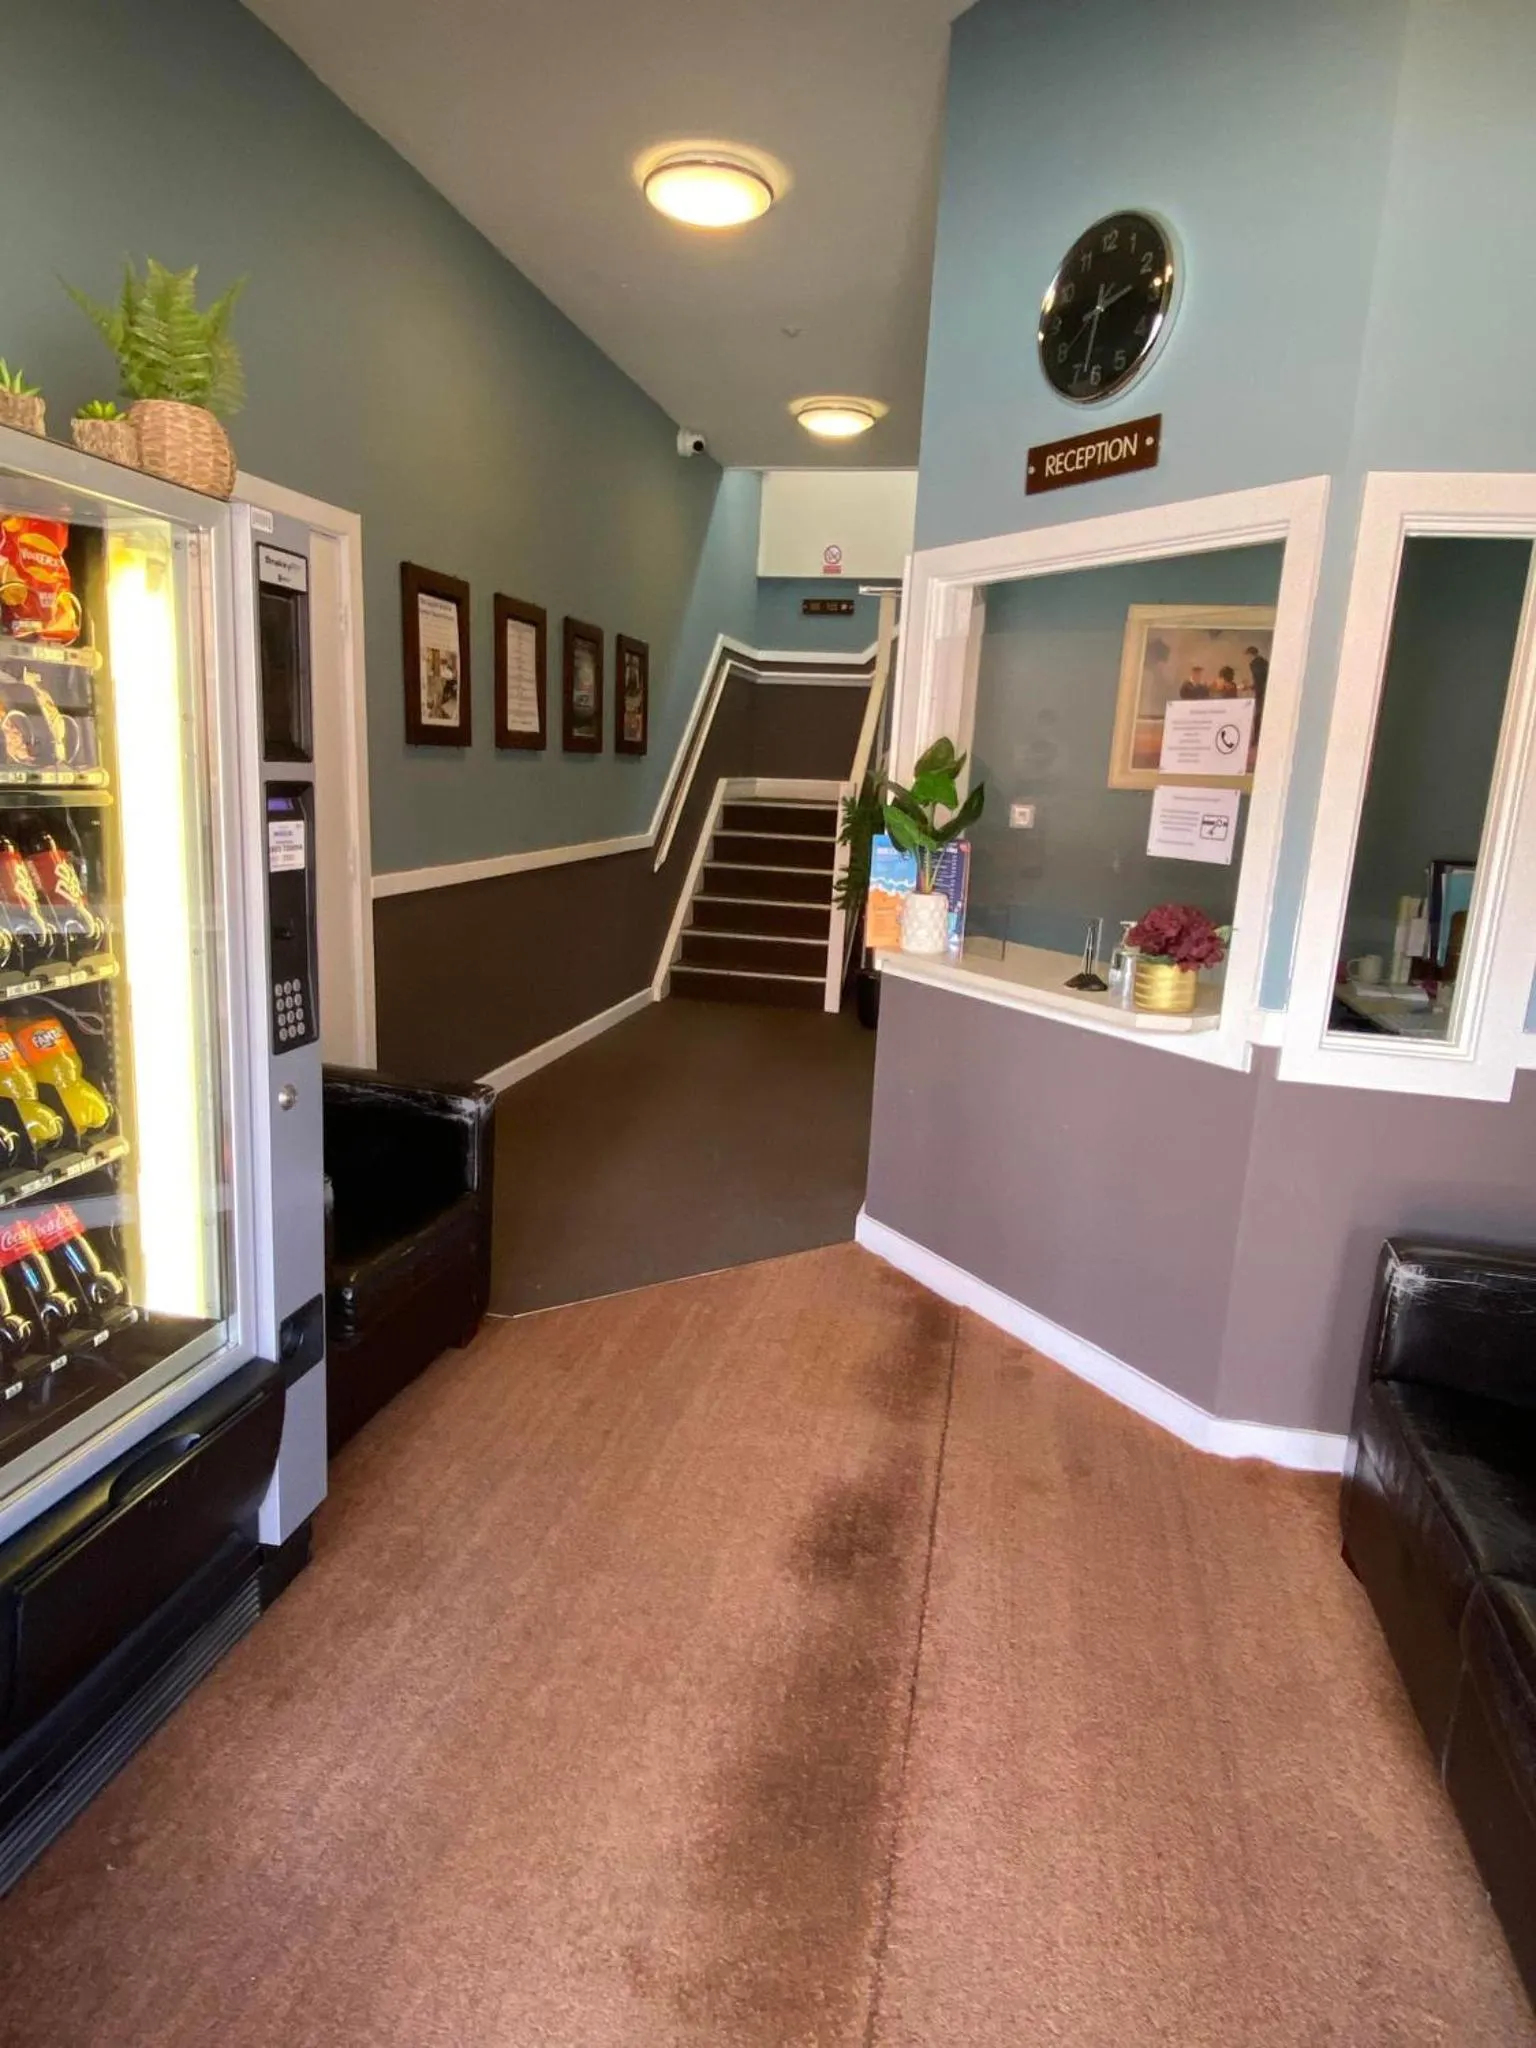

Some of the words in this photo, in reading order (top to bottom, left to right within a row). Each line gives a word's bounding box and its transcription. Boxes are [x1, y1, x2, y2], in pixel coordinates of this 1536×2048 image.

[1101, 229, 1120, 253] 12
[1128, 232, 1138, 254] 1
[1080, 252, 1094, 274] 11
[1139, 251, 1154, 274] 2
[1061, 283, 1075, 304] 10
[1133, 316, 1145, 337] 4
[1057, 342, 1069, 363] 8
[1113, 349, 1127, 371] 5
[1089, 364, 1102, 386] 6
[1045, 433, 1138, 477] RECEPTION
